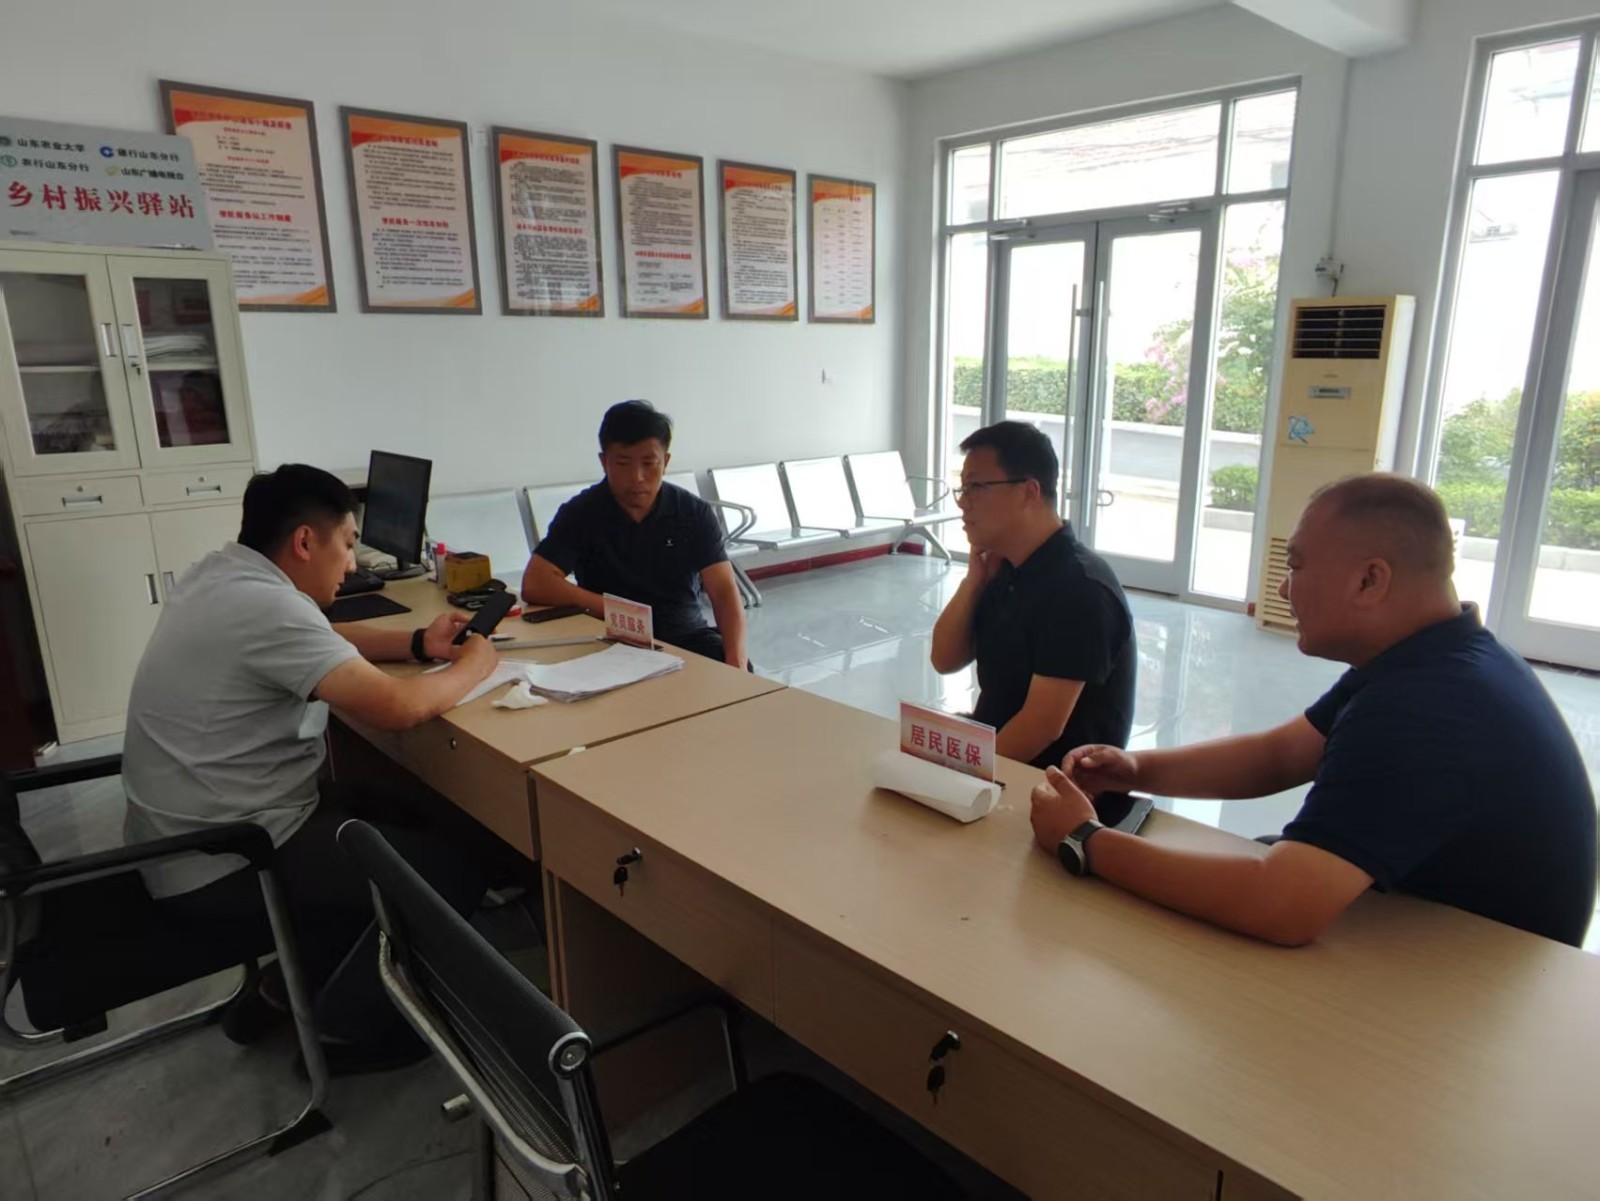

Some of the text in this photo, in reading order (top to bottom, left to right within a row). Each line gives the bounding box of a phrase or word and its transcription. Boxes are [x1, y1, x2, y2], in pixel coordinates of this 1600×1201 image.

[17, 137, 85, 152] 山东农业大学
[21, 158, 90, 173] 农行山东分行
[8, 180, 195, 219] 乡村振兴驿站
[911, 724, 983, 767] 居民医保
